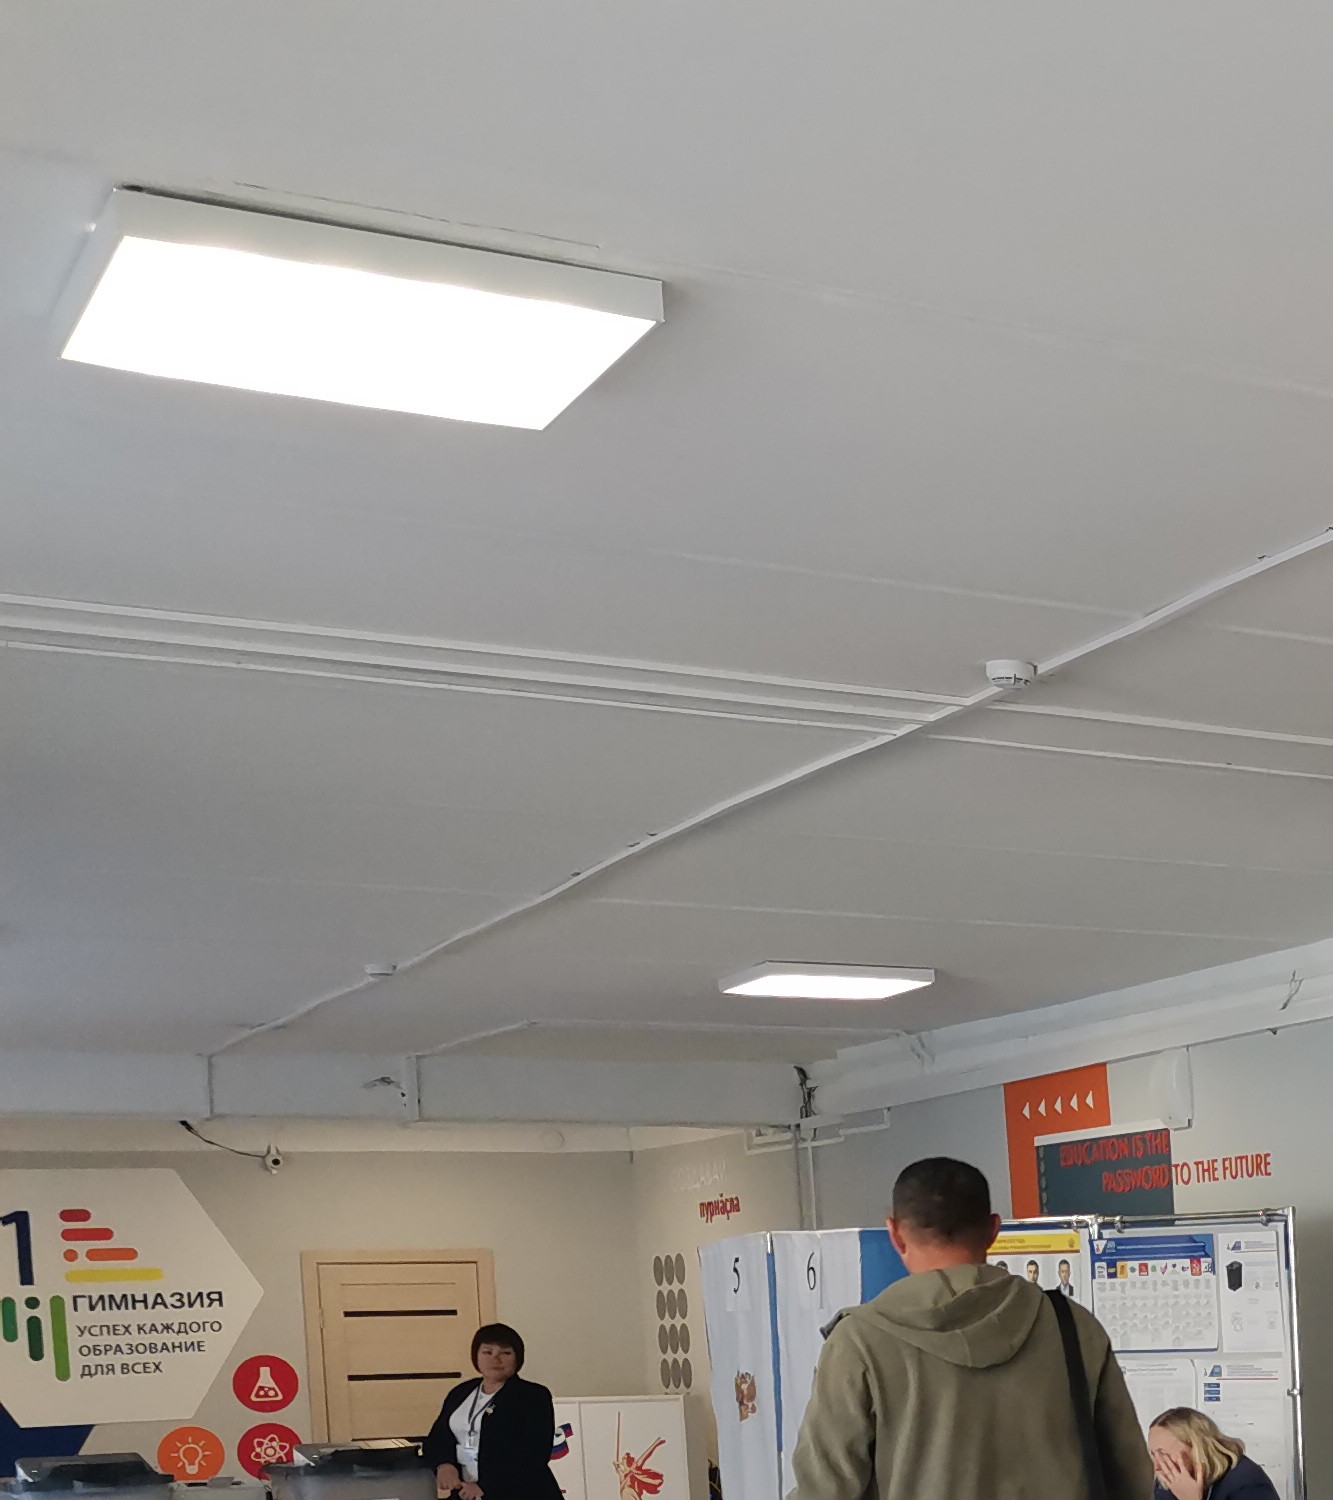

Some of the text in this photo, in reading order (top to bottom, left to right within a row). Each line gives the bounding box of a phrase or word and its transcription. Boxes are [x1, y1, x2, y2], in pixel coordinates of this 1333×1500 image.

[1144, 1130, 1171, 1156] THE
[1103, 1152, 1272, 1193] PASSWORD TO THE FUTURE
[0, 1210, 35, 1286] 1
[732, 1256, 741, 1294] 5
[806, 1251, 817, 1291] 6
[72, 1291, 225, 1312] ГИМНАЗИЯ
[75, 1320, 223, 1338] УСПЕХ КАЖДОГО
[78, 1340, 206, 1357] ОБРАЗОВАНИЕ
[79, 1361, 163, 1379] ДЛЯ ВСЕХ
